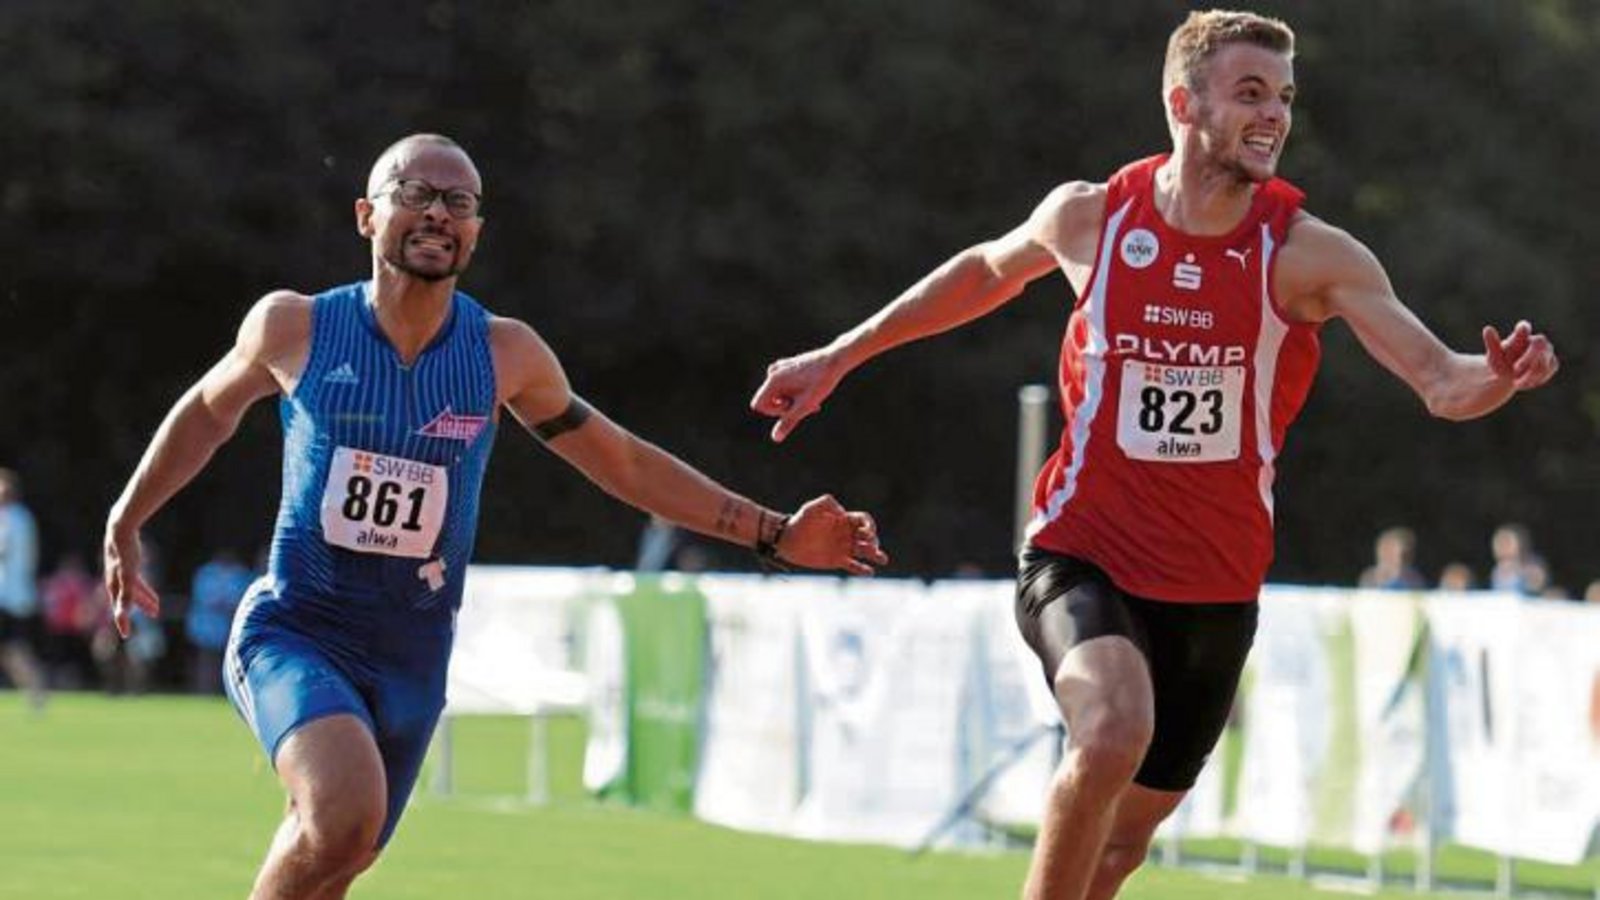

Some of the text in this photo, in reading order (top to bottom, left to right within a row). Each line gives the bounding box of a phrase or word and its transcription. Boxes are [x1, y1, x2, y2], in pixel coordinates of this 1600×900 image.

[1138, 386, 1224, 435] 823
[1157, 437, 1202, 457] alwa
[341, 475, 426, 532] 861
[357, 528, 399, 548] alwa
